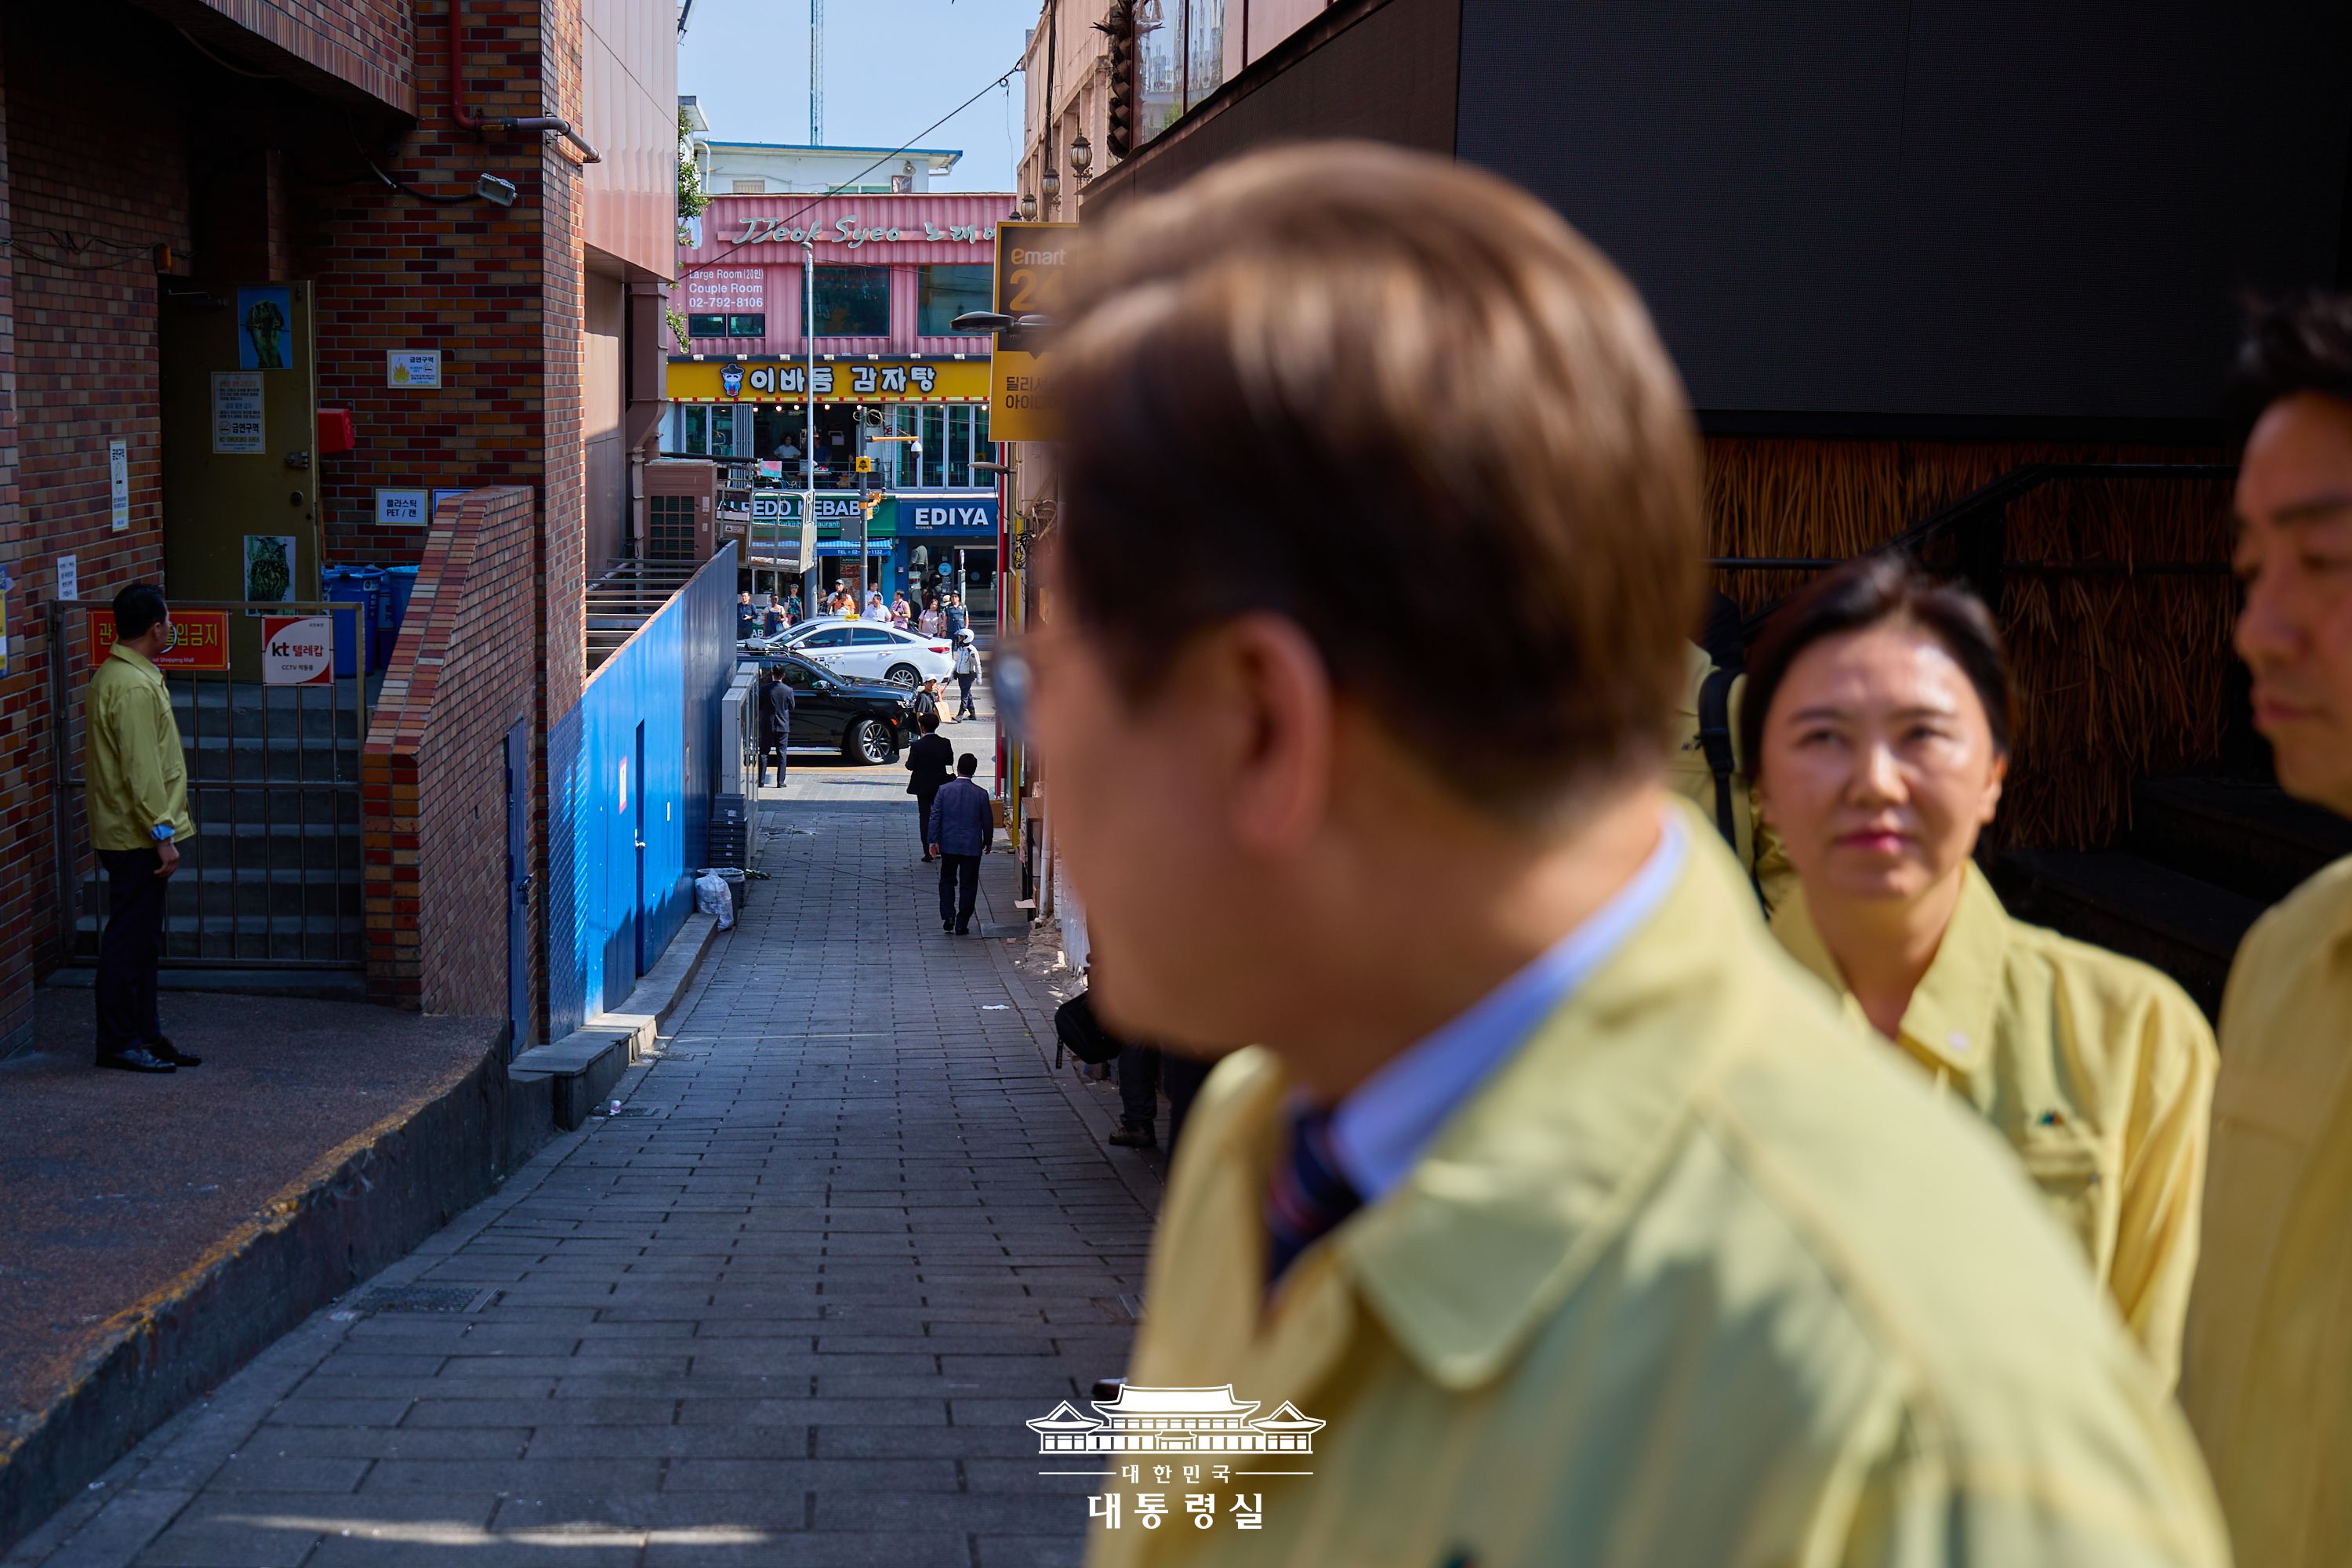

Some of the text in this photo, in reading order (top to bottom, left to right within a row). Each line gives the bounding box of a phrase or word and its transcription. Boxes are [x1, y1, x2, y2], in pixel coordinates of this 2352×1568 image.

[831, 215, 901, 249] Syeo
[1011, 248, 1067, 265] emart
[689, 269, 764, 281] Large Room (20인)
[689, 283, 763, 295] Couple Room
[689, 297, 764, 307] 02-792-8106
[750, 366, 936, 394] 이바돔 감자탕
[232, 423, 260, 434] 금연구역
[387, 499, 416, 508] 플라스틱
[915, 508, 989, 525] EDIYA
[272, 642, 324, 657] kt 텔레캅
